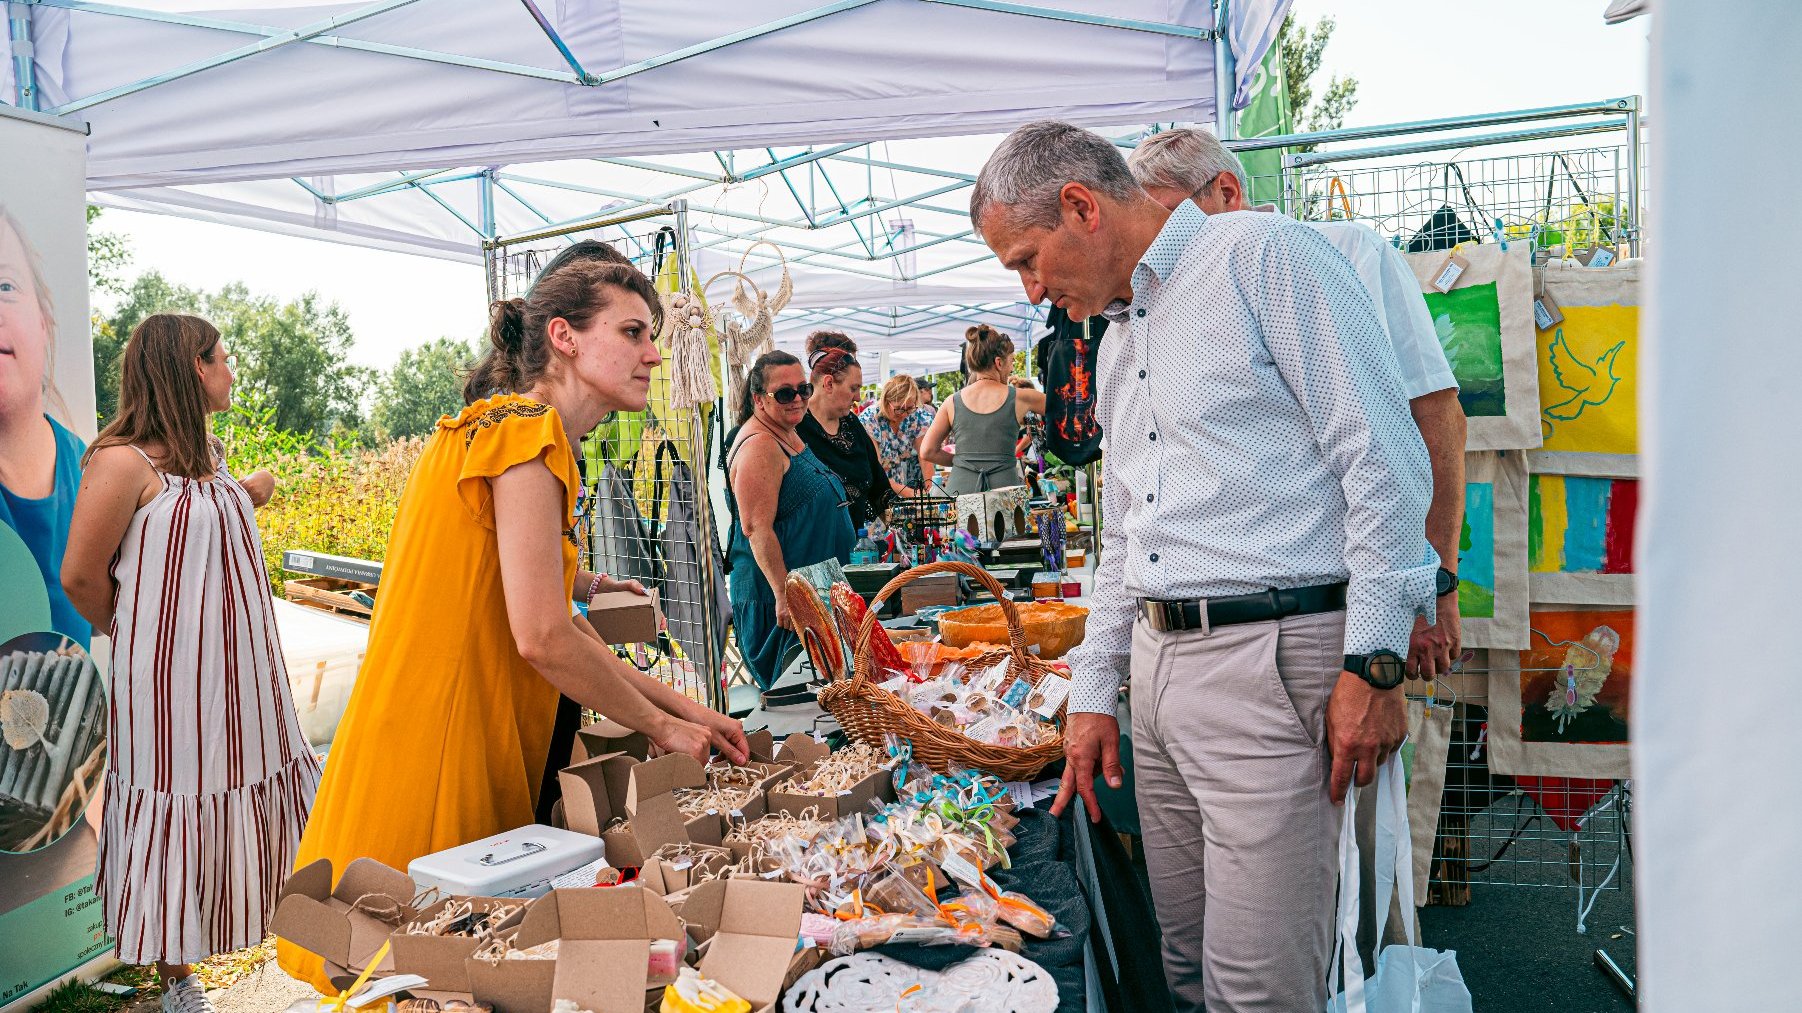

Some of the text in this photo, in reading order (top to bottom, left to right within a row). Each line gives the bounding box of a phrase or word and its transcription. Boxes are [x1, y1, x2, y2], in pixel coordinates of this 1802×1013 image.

[64, 892, 76, 904] FB:
[64, 895, 102, 918] IG: @takan
[2, 980, 28, 1000] Na Tak
